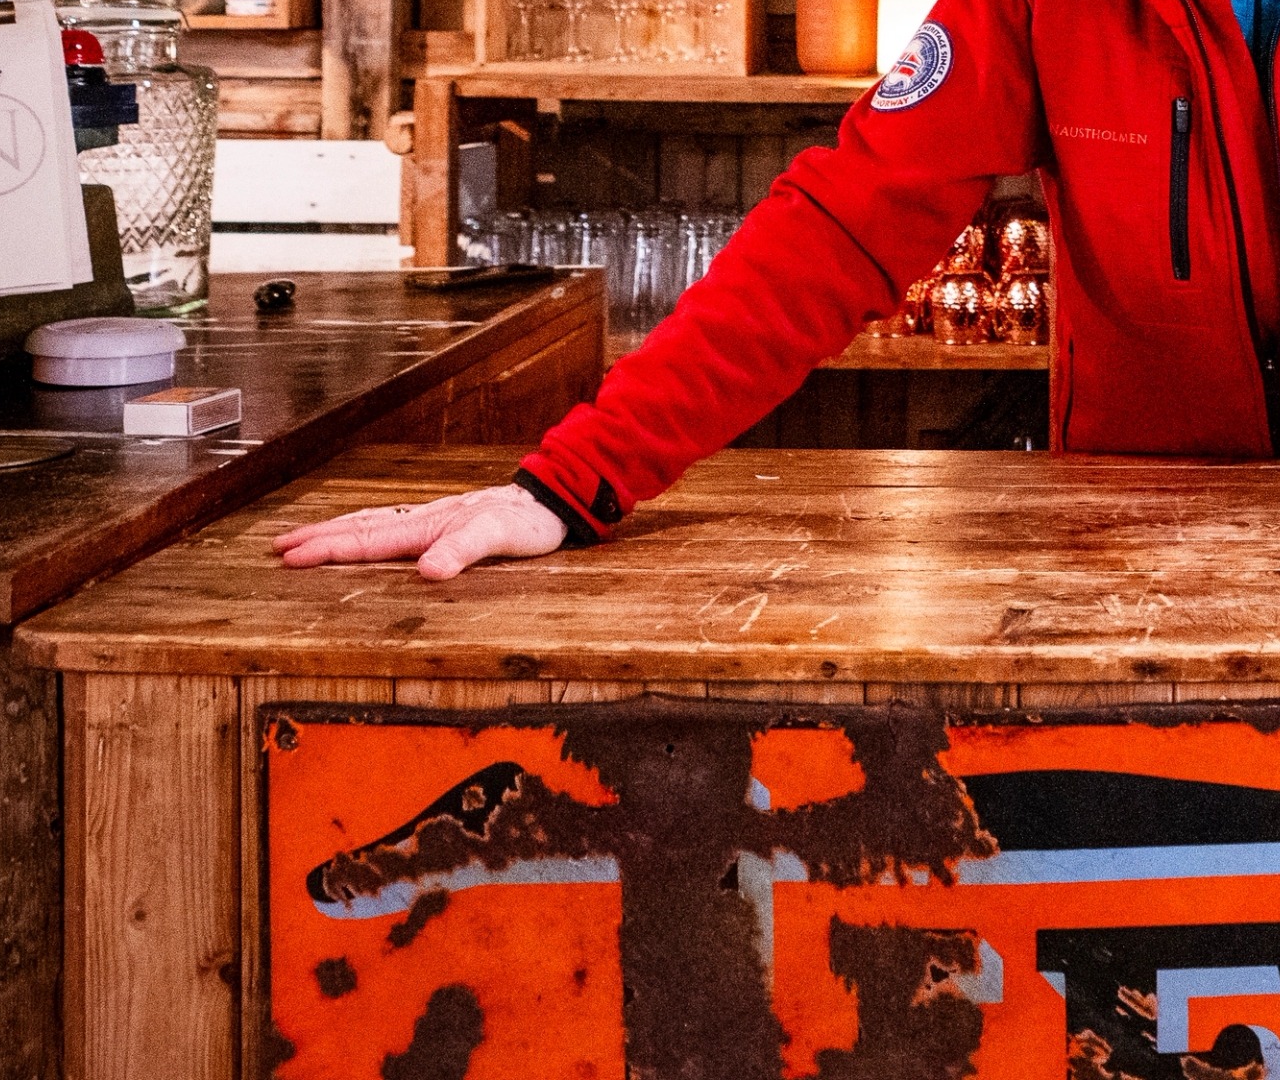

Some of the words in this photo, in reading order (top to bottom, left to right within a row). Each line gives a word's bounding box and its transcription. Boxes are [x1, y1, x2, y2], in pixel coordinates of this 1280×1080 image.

[937, 51, 948, 75] SINCE
[917, 78, 939, 98] 1887
[1049, 123, 1148, 145] NAUSTHOLMEN
